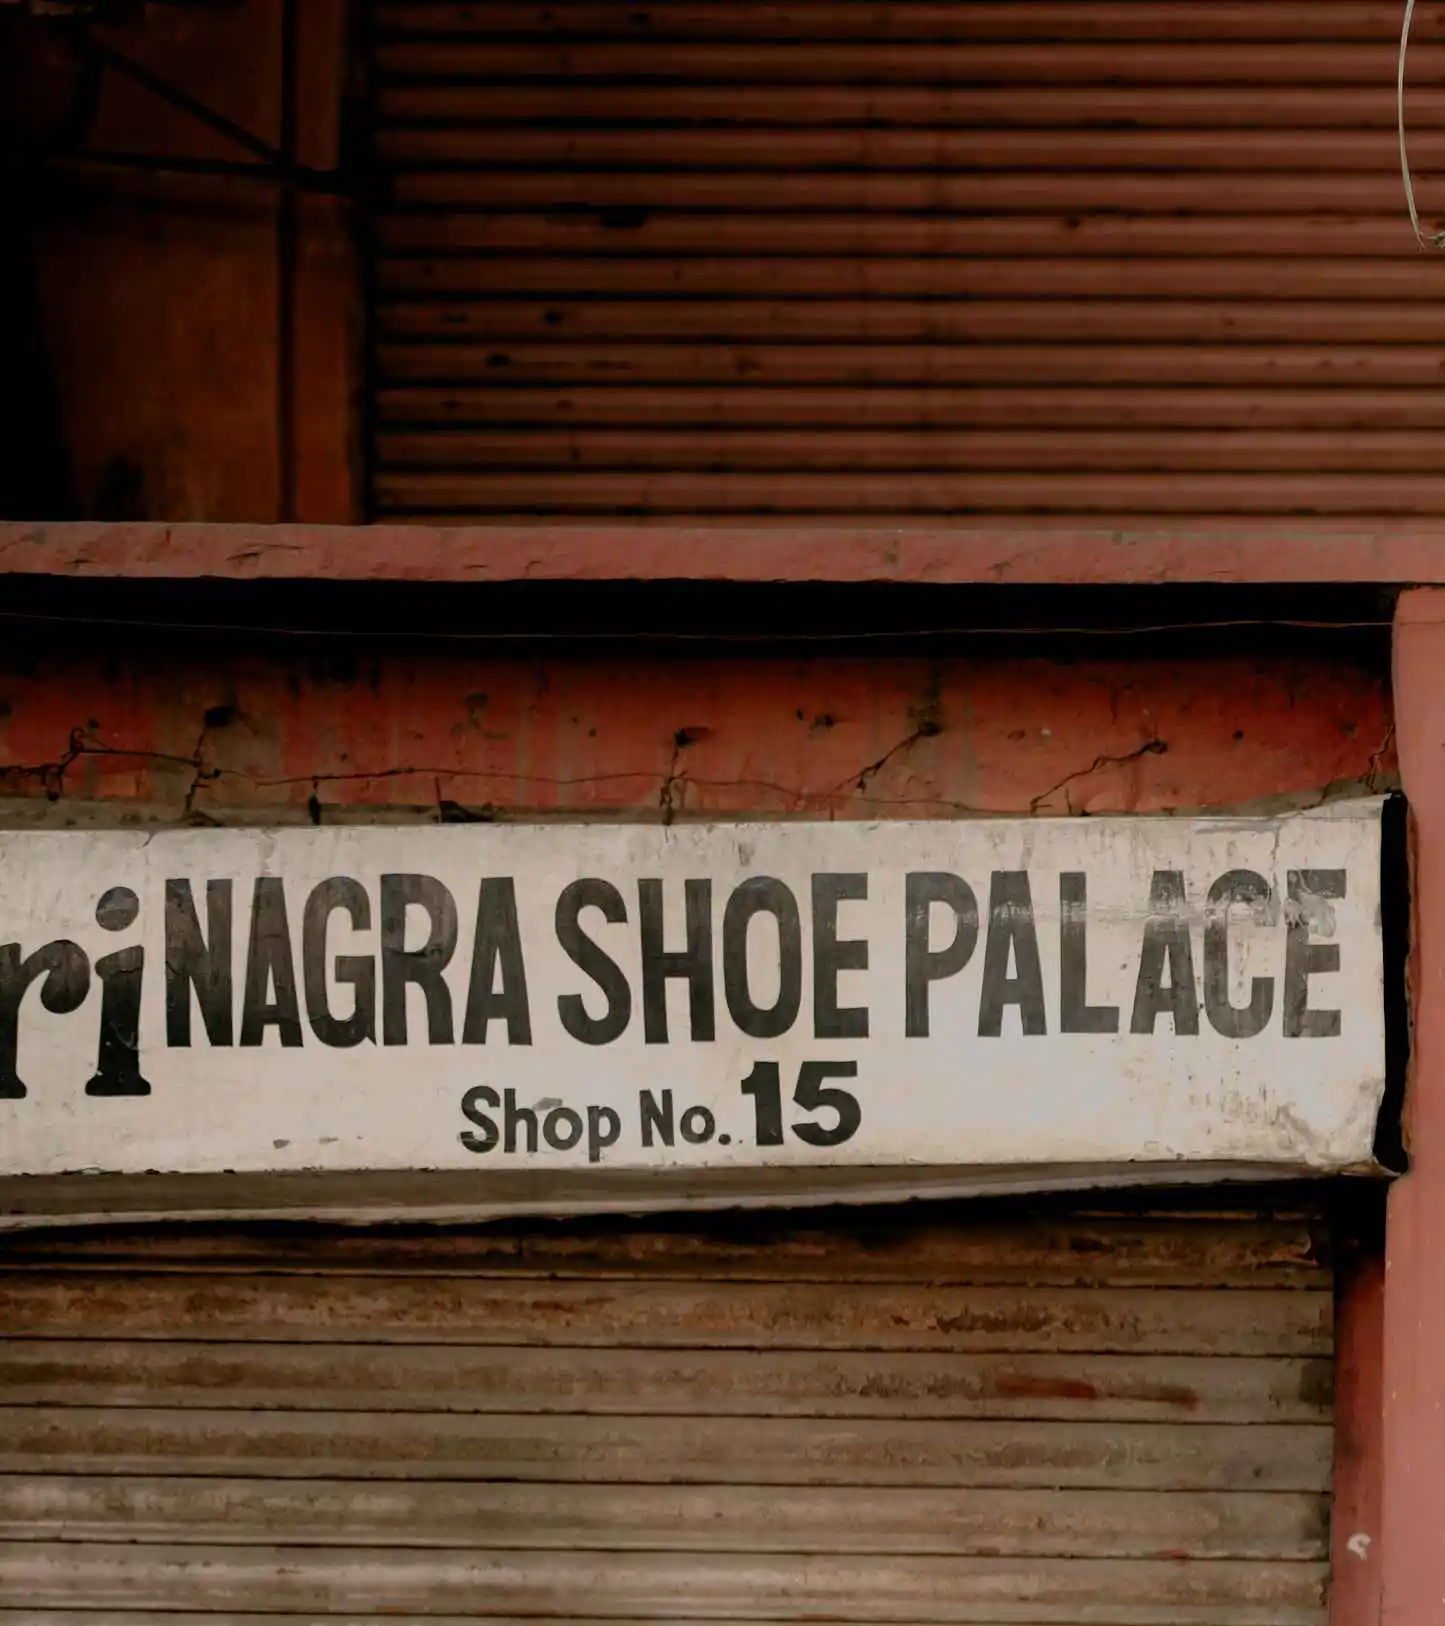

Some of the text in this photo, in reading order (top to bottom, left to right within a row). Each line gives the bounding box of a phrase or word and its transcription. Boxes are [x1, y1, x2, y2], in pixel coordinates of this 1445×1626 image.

[0, 869, 1347, 1099] ri NAGRA SHOE PALACE
[459, 1060, 863, 1163] Shop No. 15
